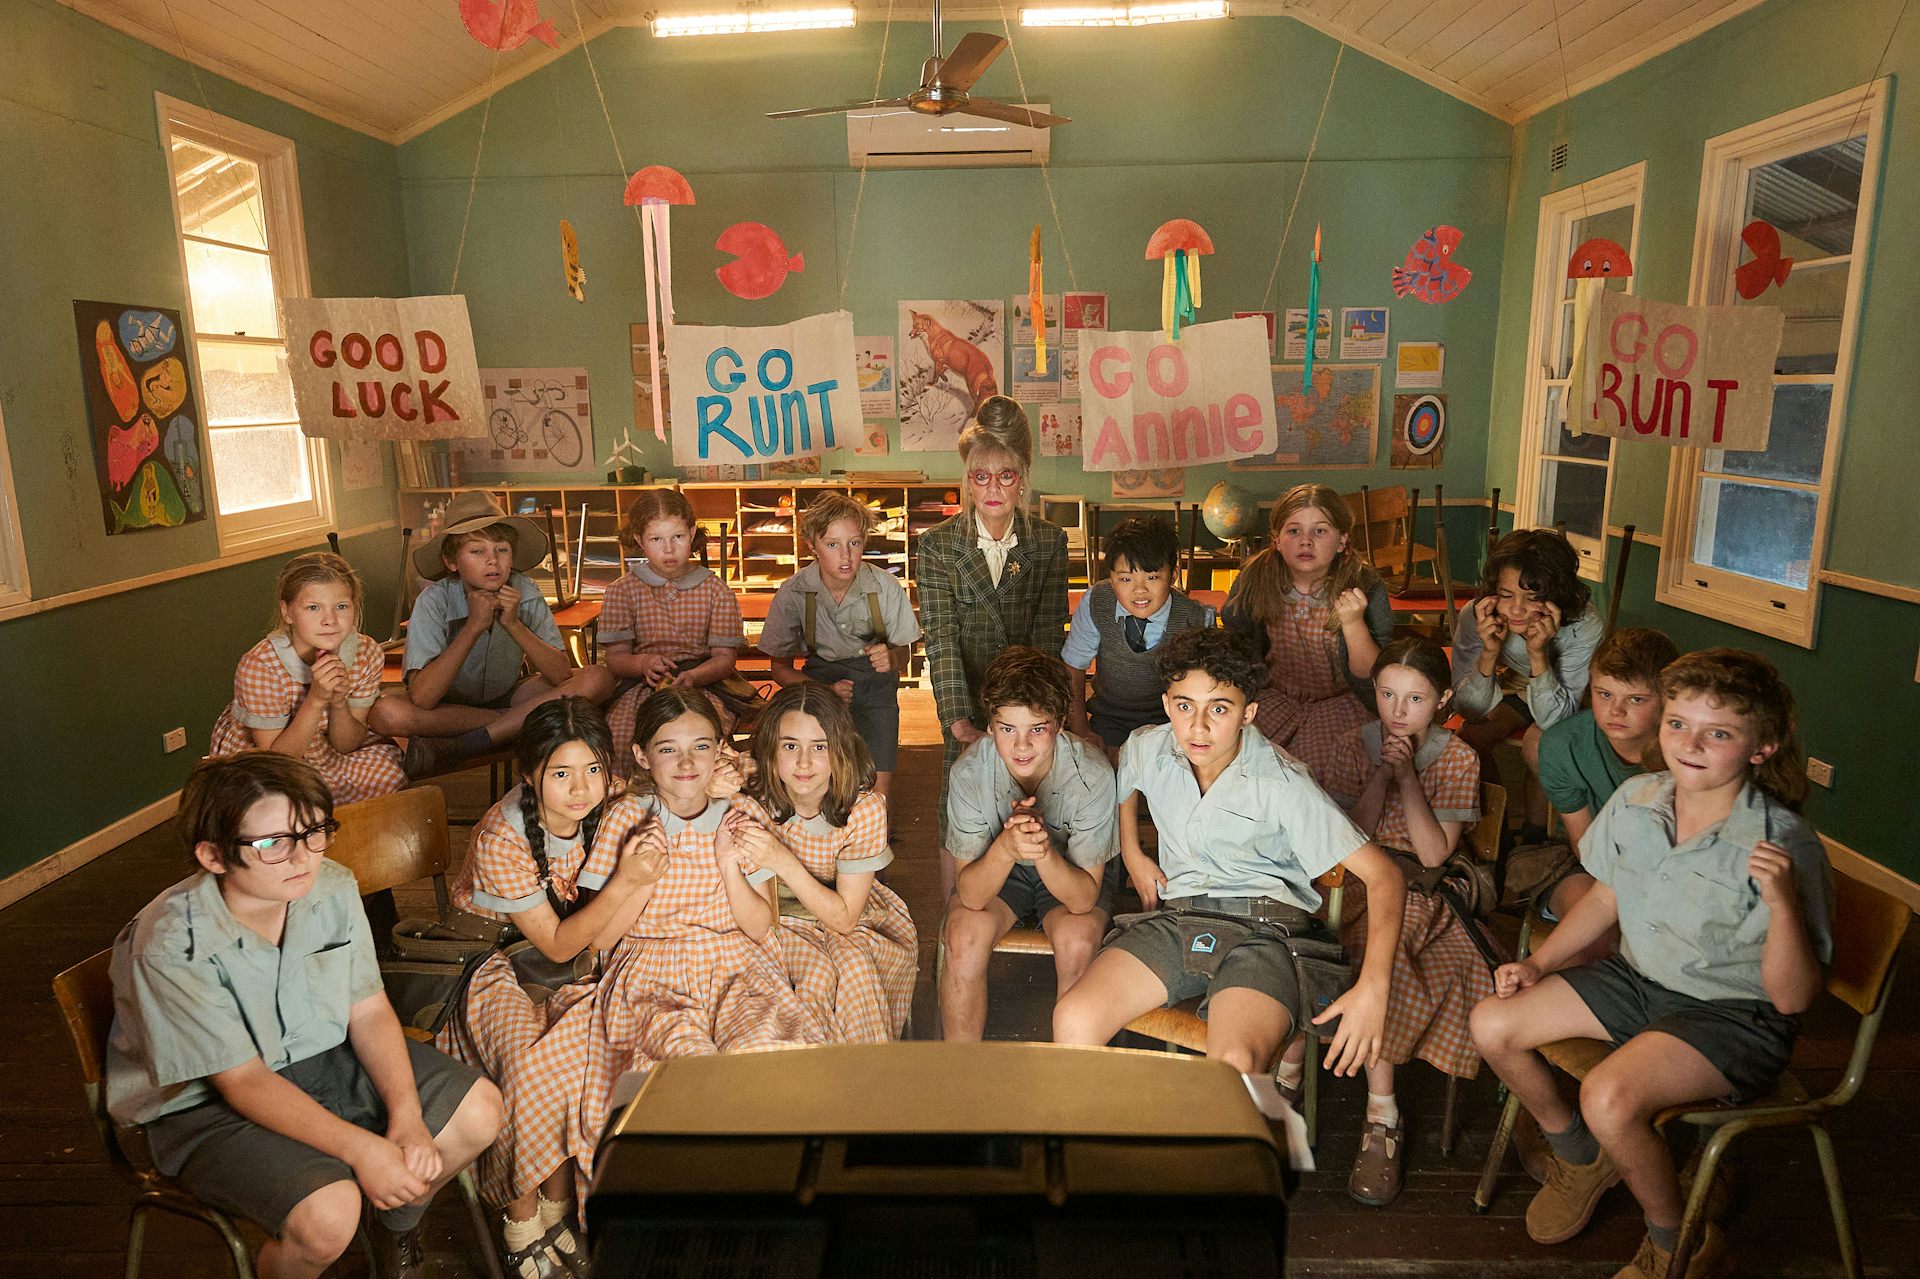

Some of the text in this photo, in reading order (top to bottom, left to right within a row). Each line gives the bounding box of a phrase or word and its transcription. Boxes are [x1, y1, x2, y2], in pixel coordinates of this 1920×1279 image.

[310, 330, 447, 373] GOOD
[1610, 312, 1698, 378] GO
[706, 347, 793, 393] GO
[1089, 344, 1189, 399] GO
[332, 380, 460, 424] LUCK
